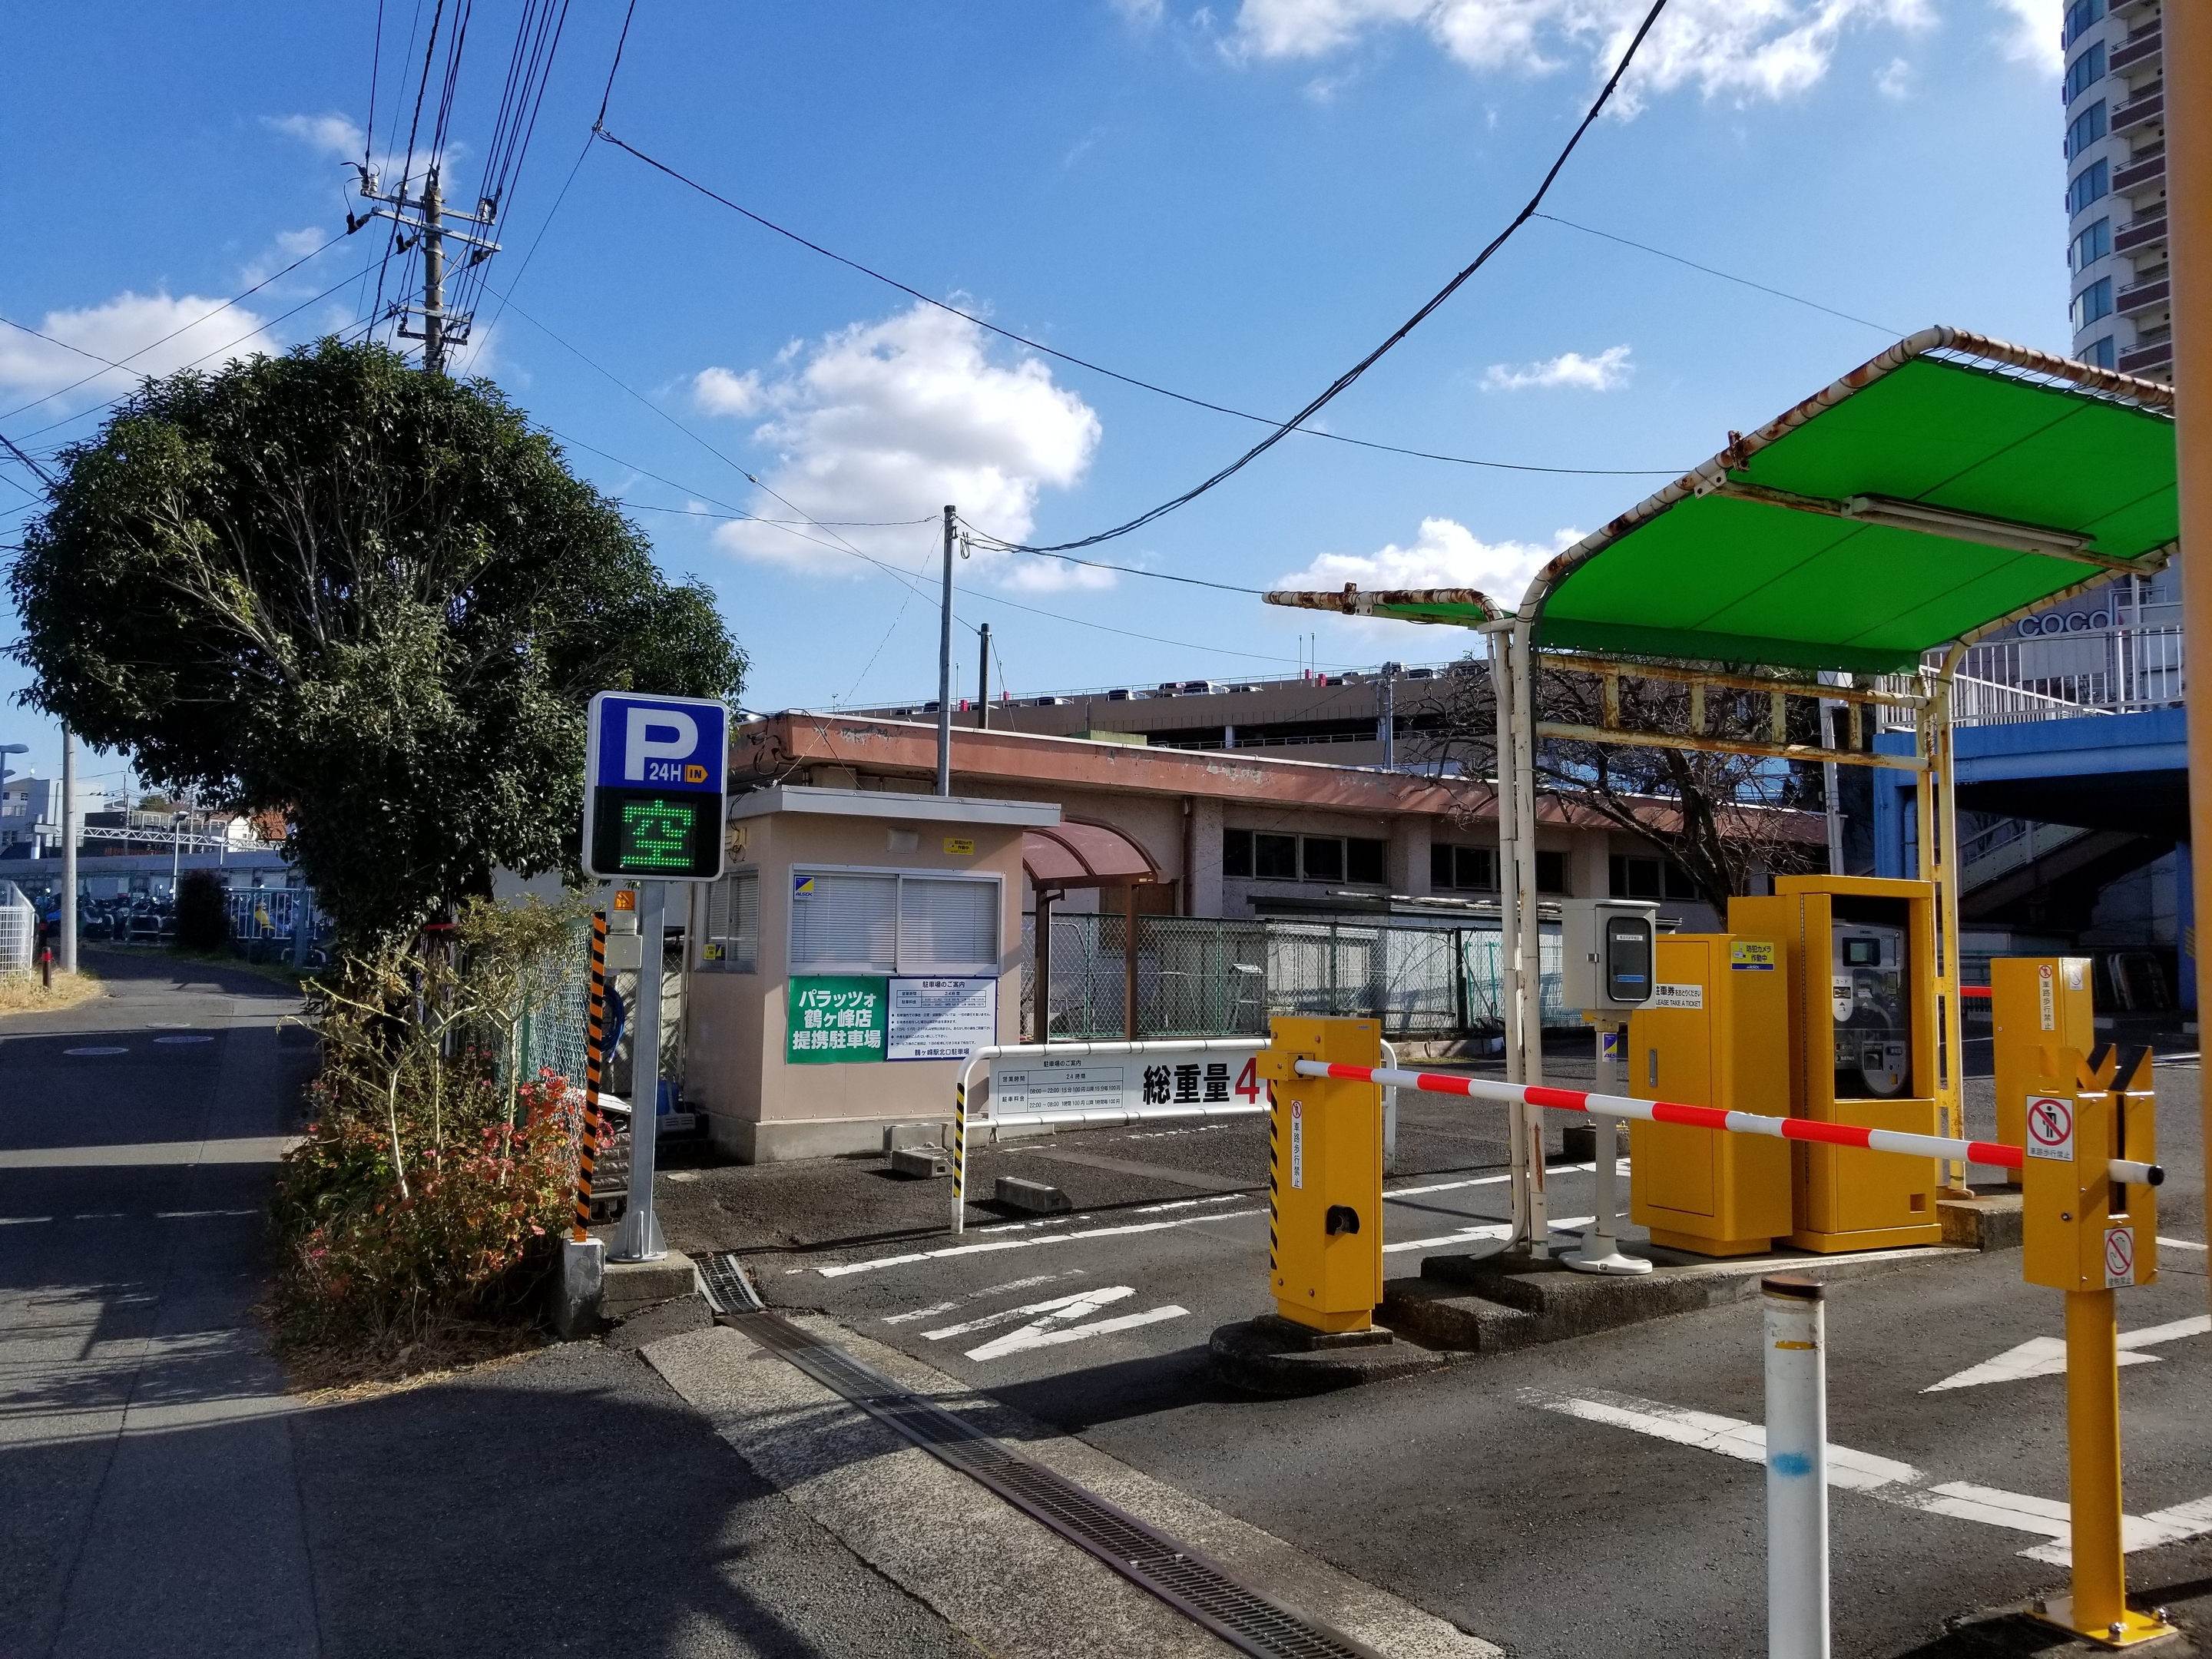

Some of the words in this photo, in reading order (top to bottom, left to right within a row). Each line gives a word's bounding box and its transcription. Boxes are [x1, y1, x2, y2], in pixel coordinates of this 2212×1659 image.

[624, 707, 698, 781] P
[650, 763, 681, 782] 24H
[690, 770, 702, 779] IN
[621, 800, 694, 866] 空
[799, 989, 877, 1008] パラッツォ
[2042, 981, 2052, 1029] 車路歩行禁止
[793, 1029, 882, 1050] 提携駐車場
[2029, 1147, 2071, 1160] 車路歩行禁止
